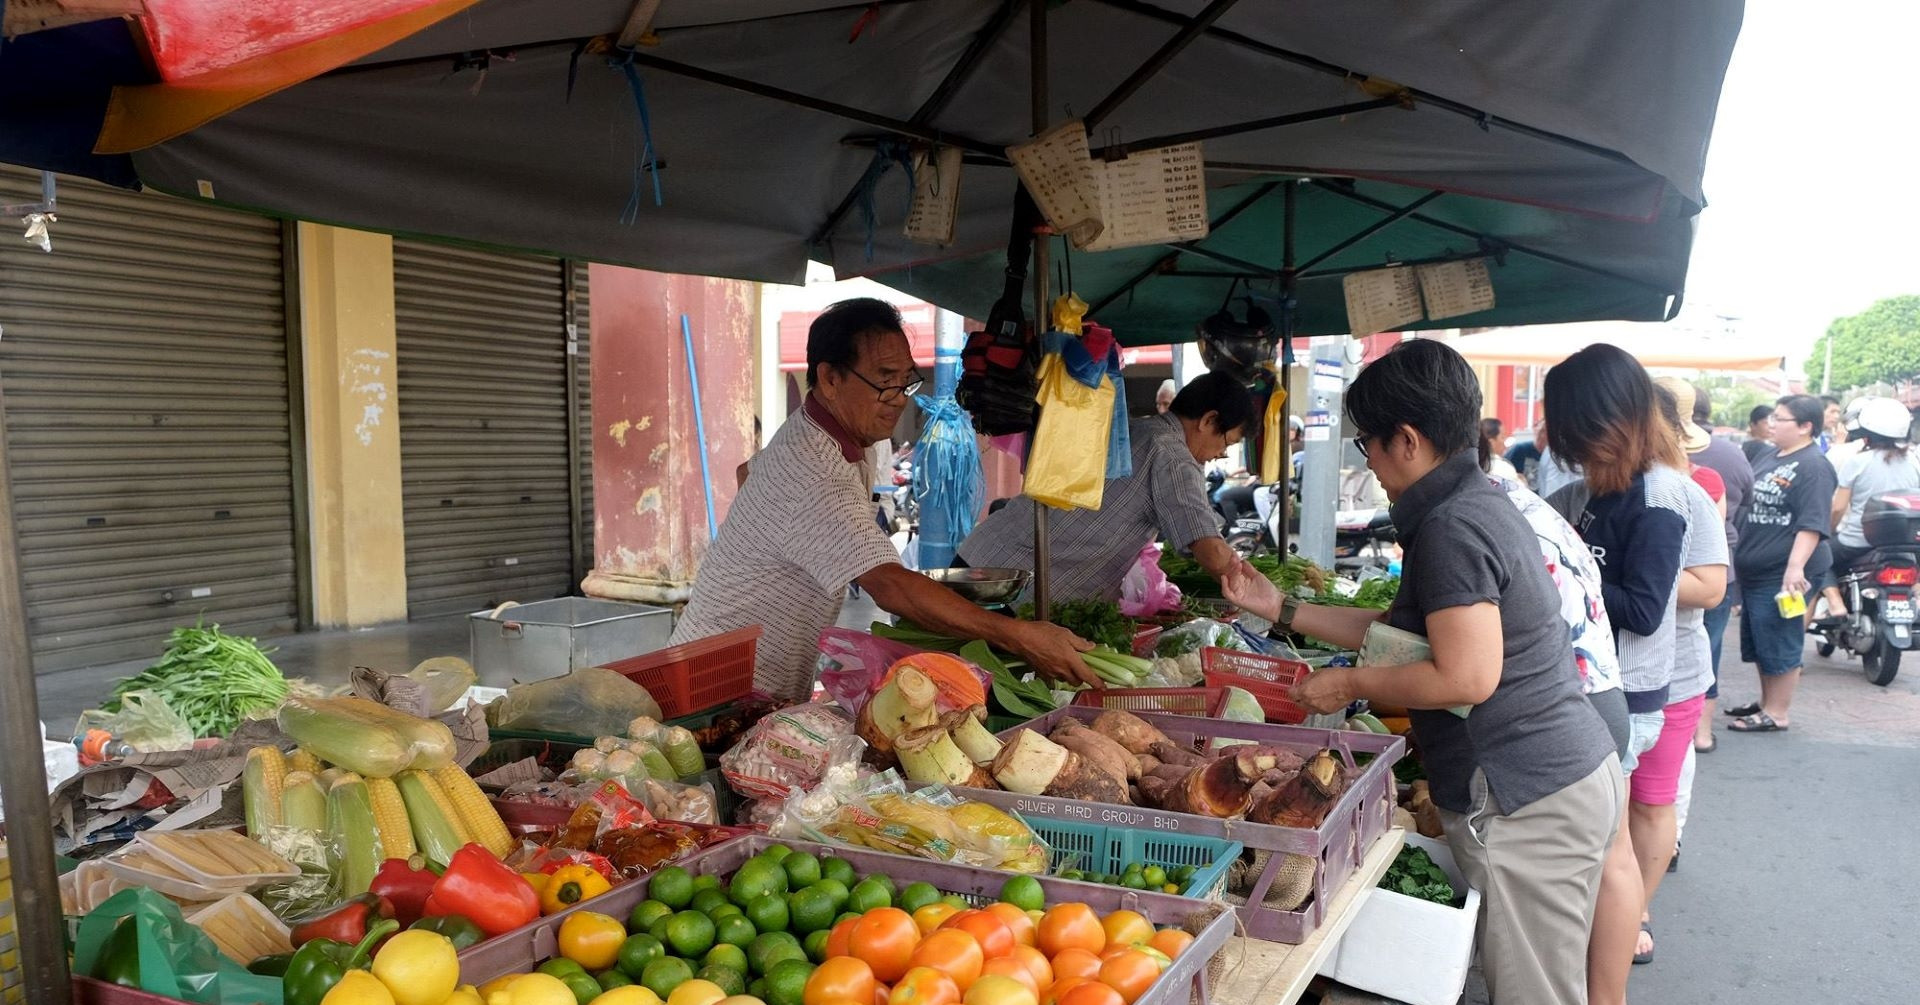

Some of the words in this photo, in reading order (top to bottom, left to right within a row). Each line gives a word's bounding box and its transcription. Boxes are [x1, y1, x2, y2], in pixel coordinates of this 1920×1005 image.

[1585, 543, 1607, 566] R
[1016, 799, 1056, 814] SILVER
[1064, 804, 1092, 819] BIRD
[1101, 809, 1144, 825] GROUP
[1153, 817, 1179, 830] BHD
